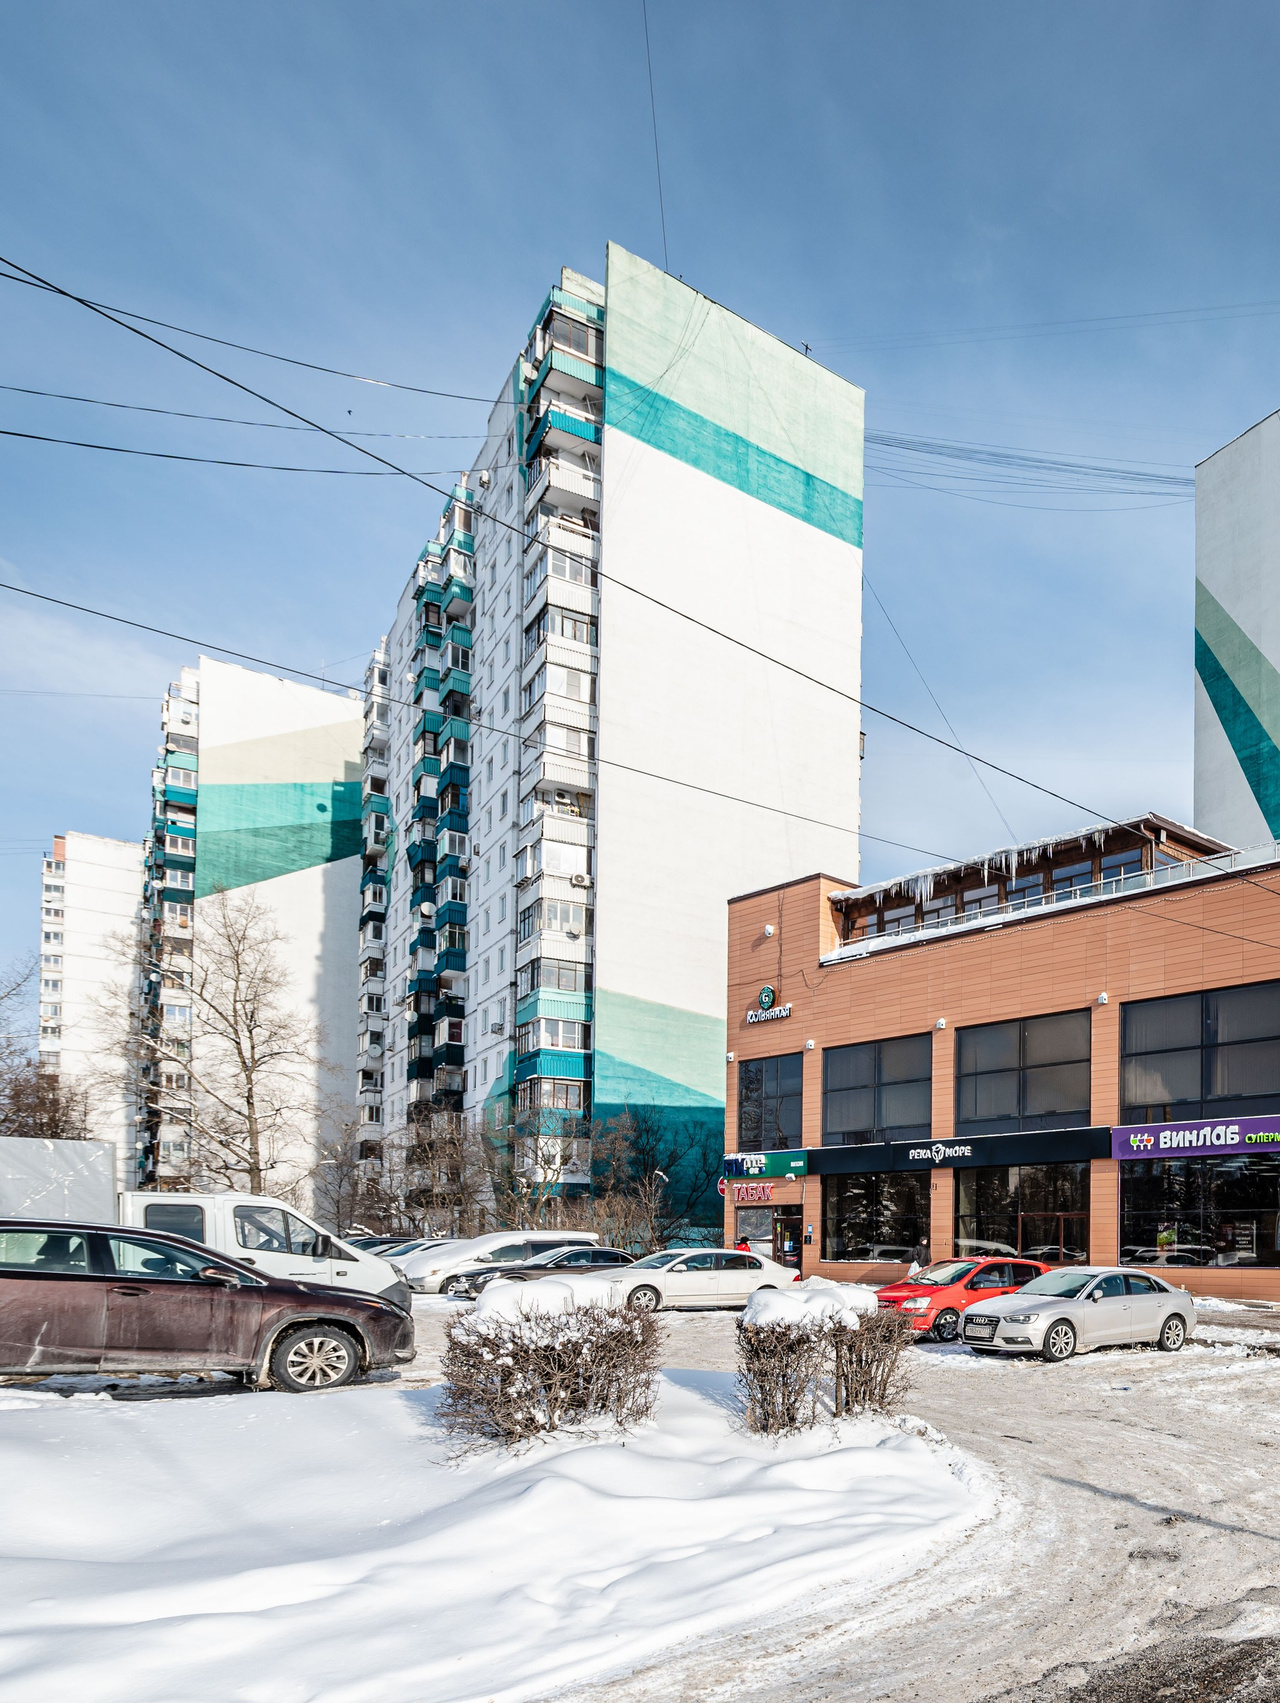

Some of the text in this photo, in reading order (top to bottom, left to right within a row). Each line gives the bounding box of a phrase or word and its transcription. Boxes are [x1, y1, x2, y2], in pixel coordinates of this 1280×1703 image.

[1159, 1125, 1240, 1149] ВИНЛАБ
[909, 1146, 972, 1159] РЕКА МОРЕ
[732, 1184, 774, 1201] ТАБАК
